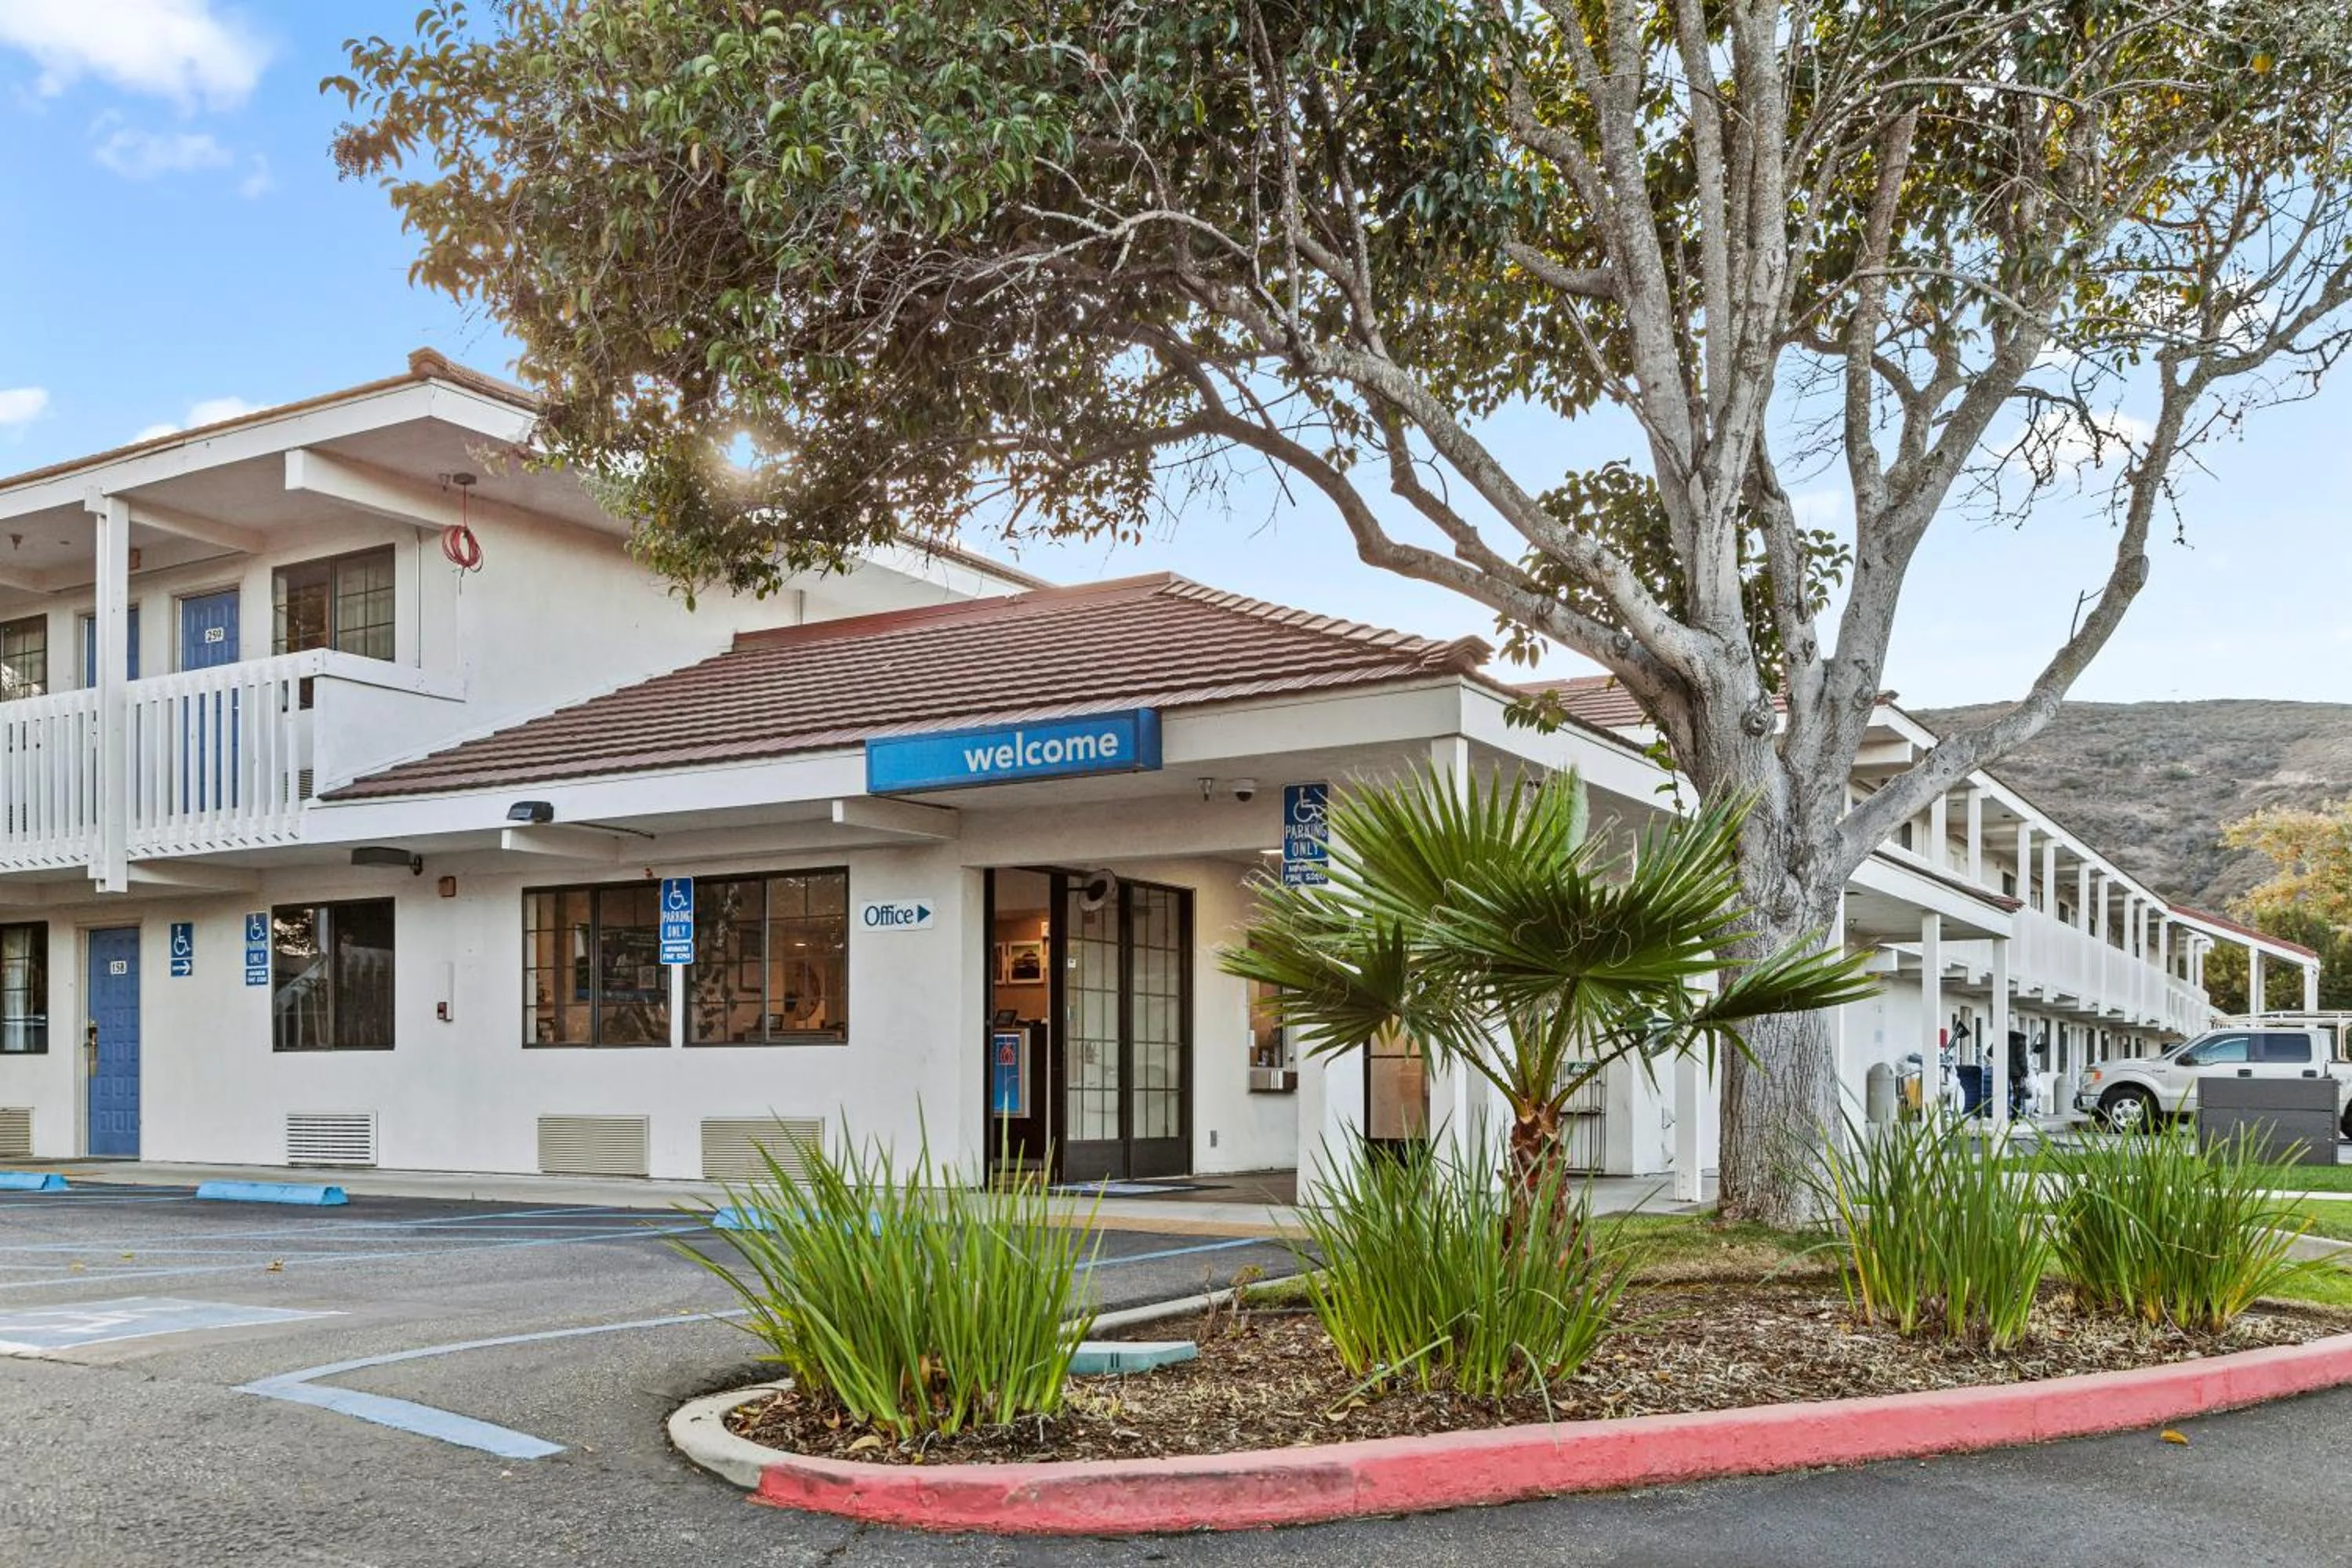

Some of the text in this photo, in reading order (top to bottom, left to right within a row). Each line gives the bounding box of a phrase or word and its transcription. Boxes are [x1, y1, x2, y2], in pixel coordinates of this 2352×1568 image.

[964, 731, 1119, 772] welcome
[1286, 824, 1327, 838] PARKING
[1291, 841, 1318, 856] ONLY
[662, 910, 691, 923] PARKING
[865, 904, 913, 926] Office
[667, 925, 686, 938] ONLY
